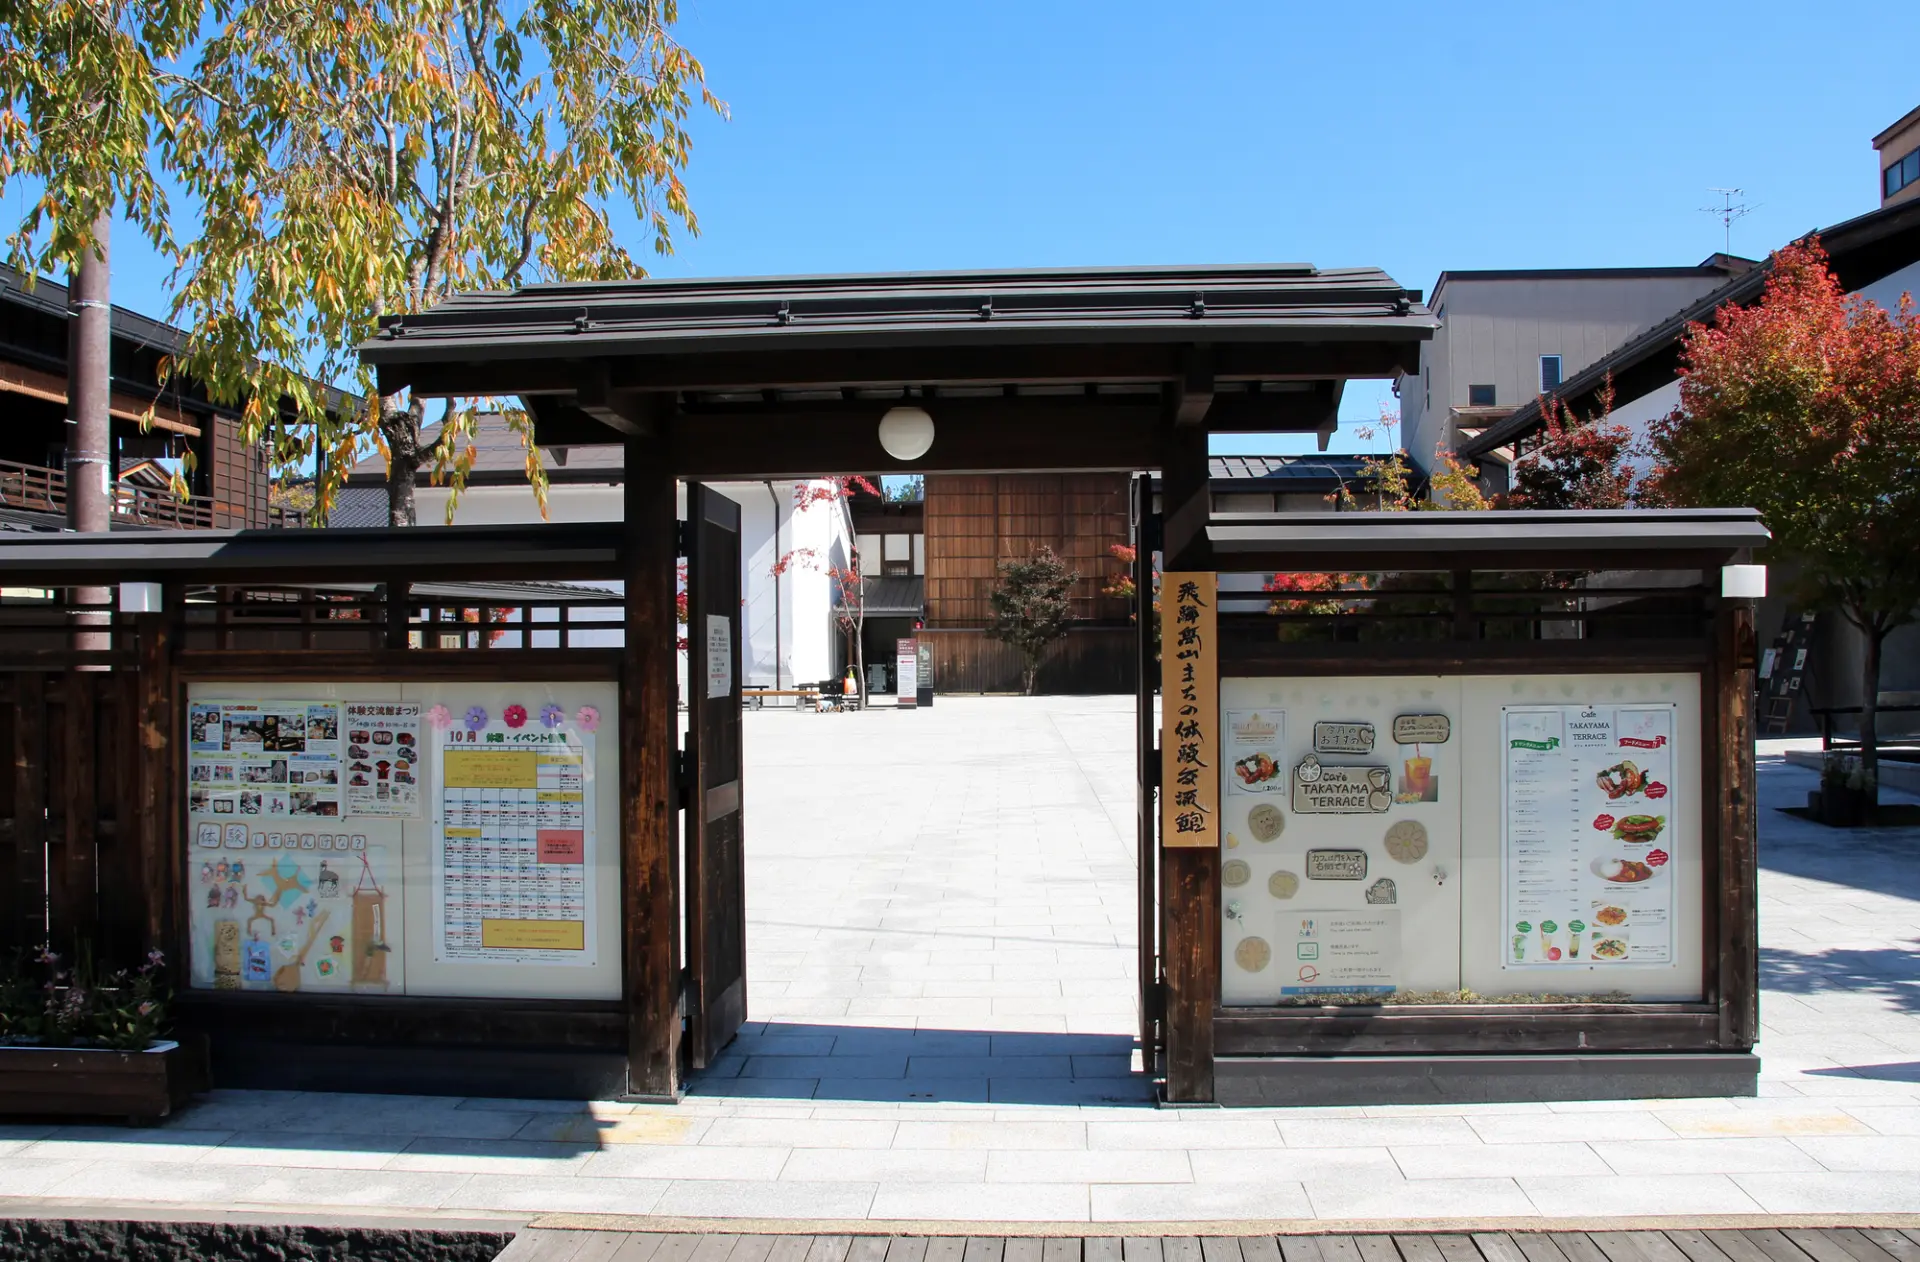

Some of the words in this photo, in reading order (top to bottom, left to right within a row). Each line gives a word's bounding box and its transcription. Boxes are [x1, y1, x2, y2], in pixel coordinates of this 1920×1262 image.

[347, 706, 419, 716] 体験交流館まつり
[1326, 725, 1357, 734] 今月の
[1320, 735, 1360, 745] おすすめ
[1573, 733, 1607, 741] TERRACE
[1623, 740, 1651, 748] フードメニュー
[1300, 783, 1369, 795] TAKAYAMA
[1309, 796, 1366, 807] TERRACE
